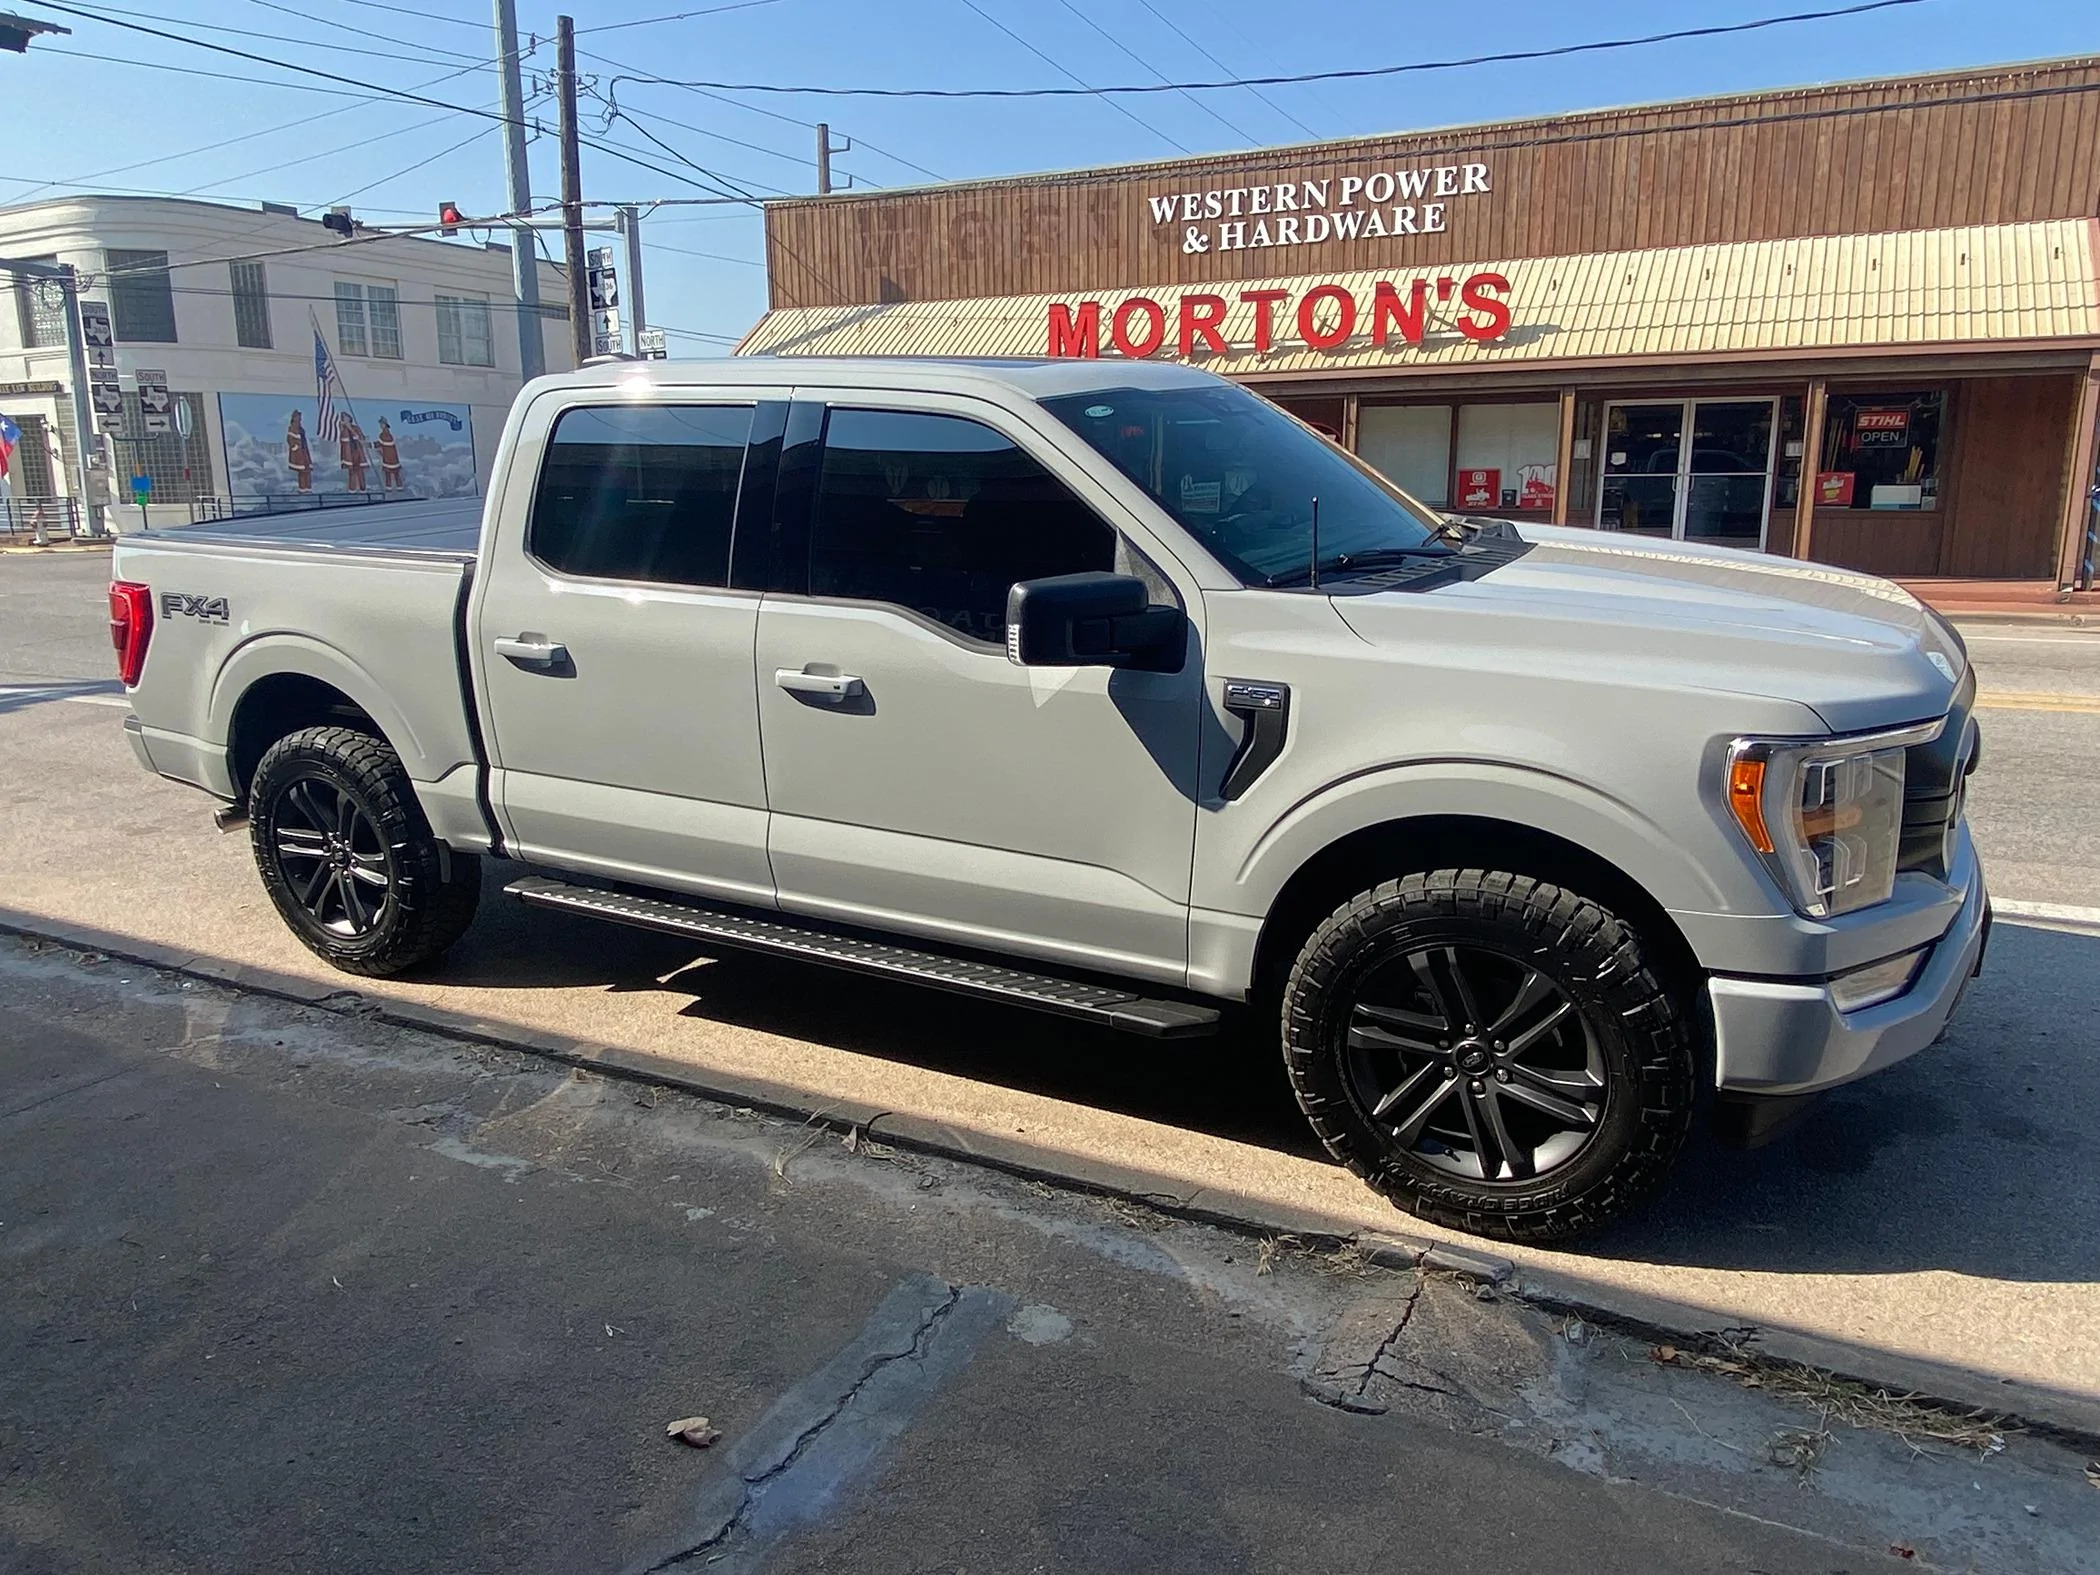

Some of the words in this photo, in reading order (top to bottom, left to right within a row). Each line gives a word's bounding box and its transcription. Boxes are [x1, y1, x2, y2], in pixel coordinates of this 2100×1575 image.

[1148, 180, 1329, 224] WESTERN
[1339, 163, 1490, 206] POWER
[1182, 226, 1209, 254] &
[1218, 203, 1446, 251] HARDWARE
[82, 305, 108, 316] SOUTH
[1047, 272, 1511, 361] MORTON'S
[597, 341, 620, 353] SOUTH
[641, 335, 664, 347] NORTH
[139, 372, 165, 381] SOUTH
[1857, 415, 1906, 427] STIHL
[1861, 431, 1900, 442] OPEN
[160, 592, 229, 620] FX4
